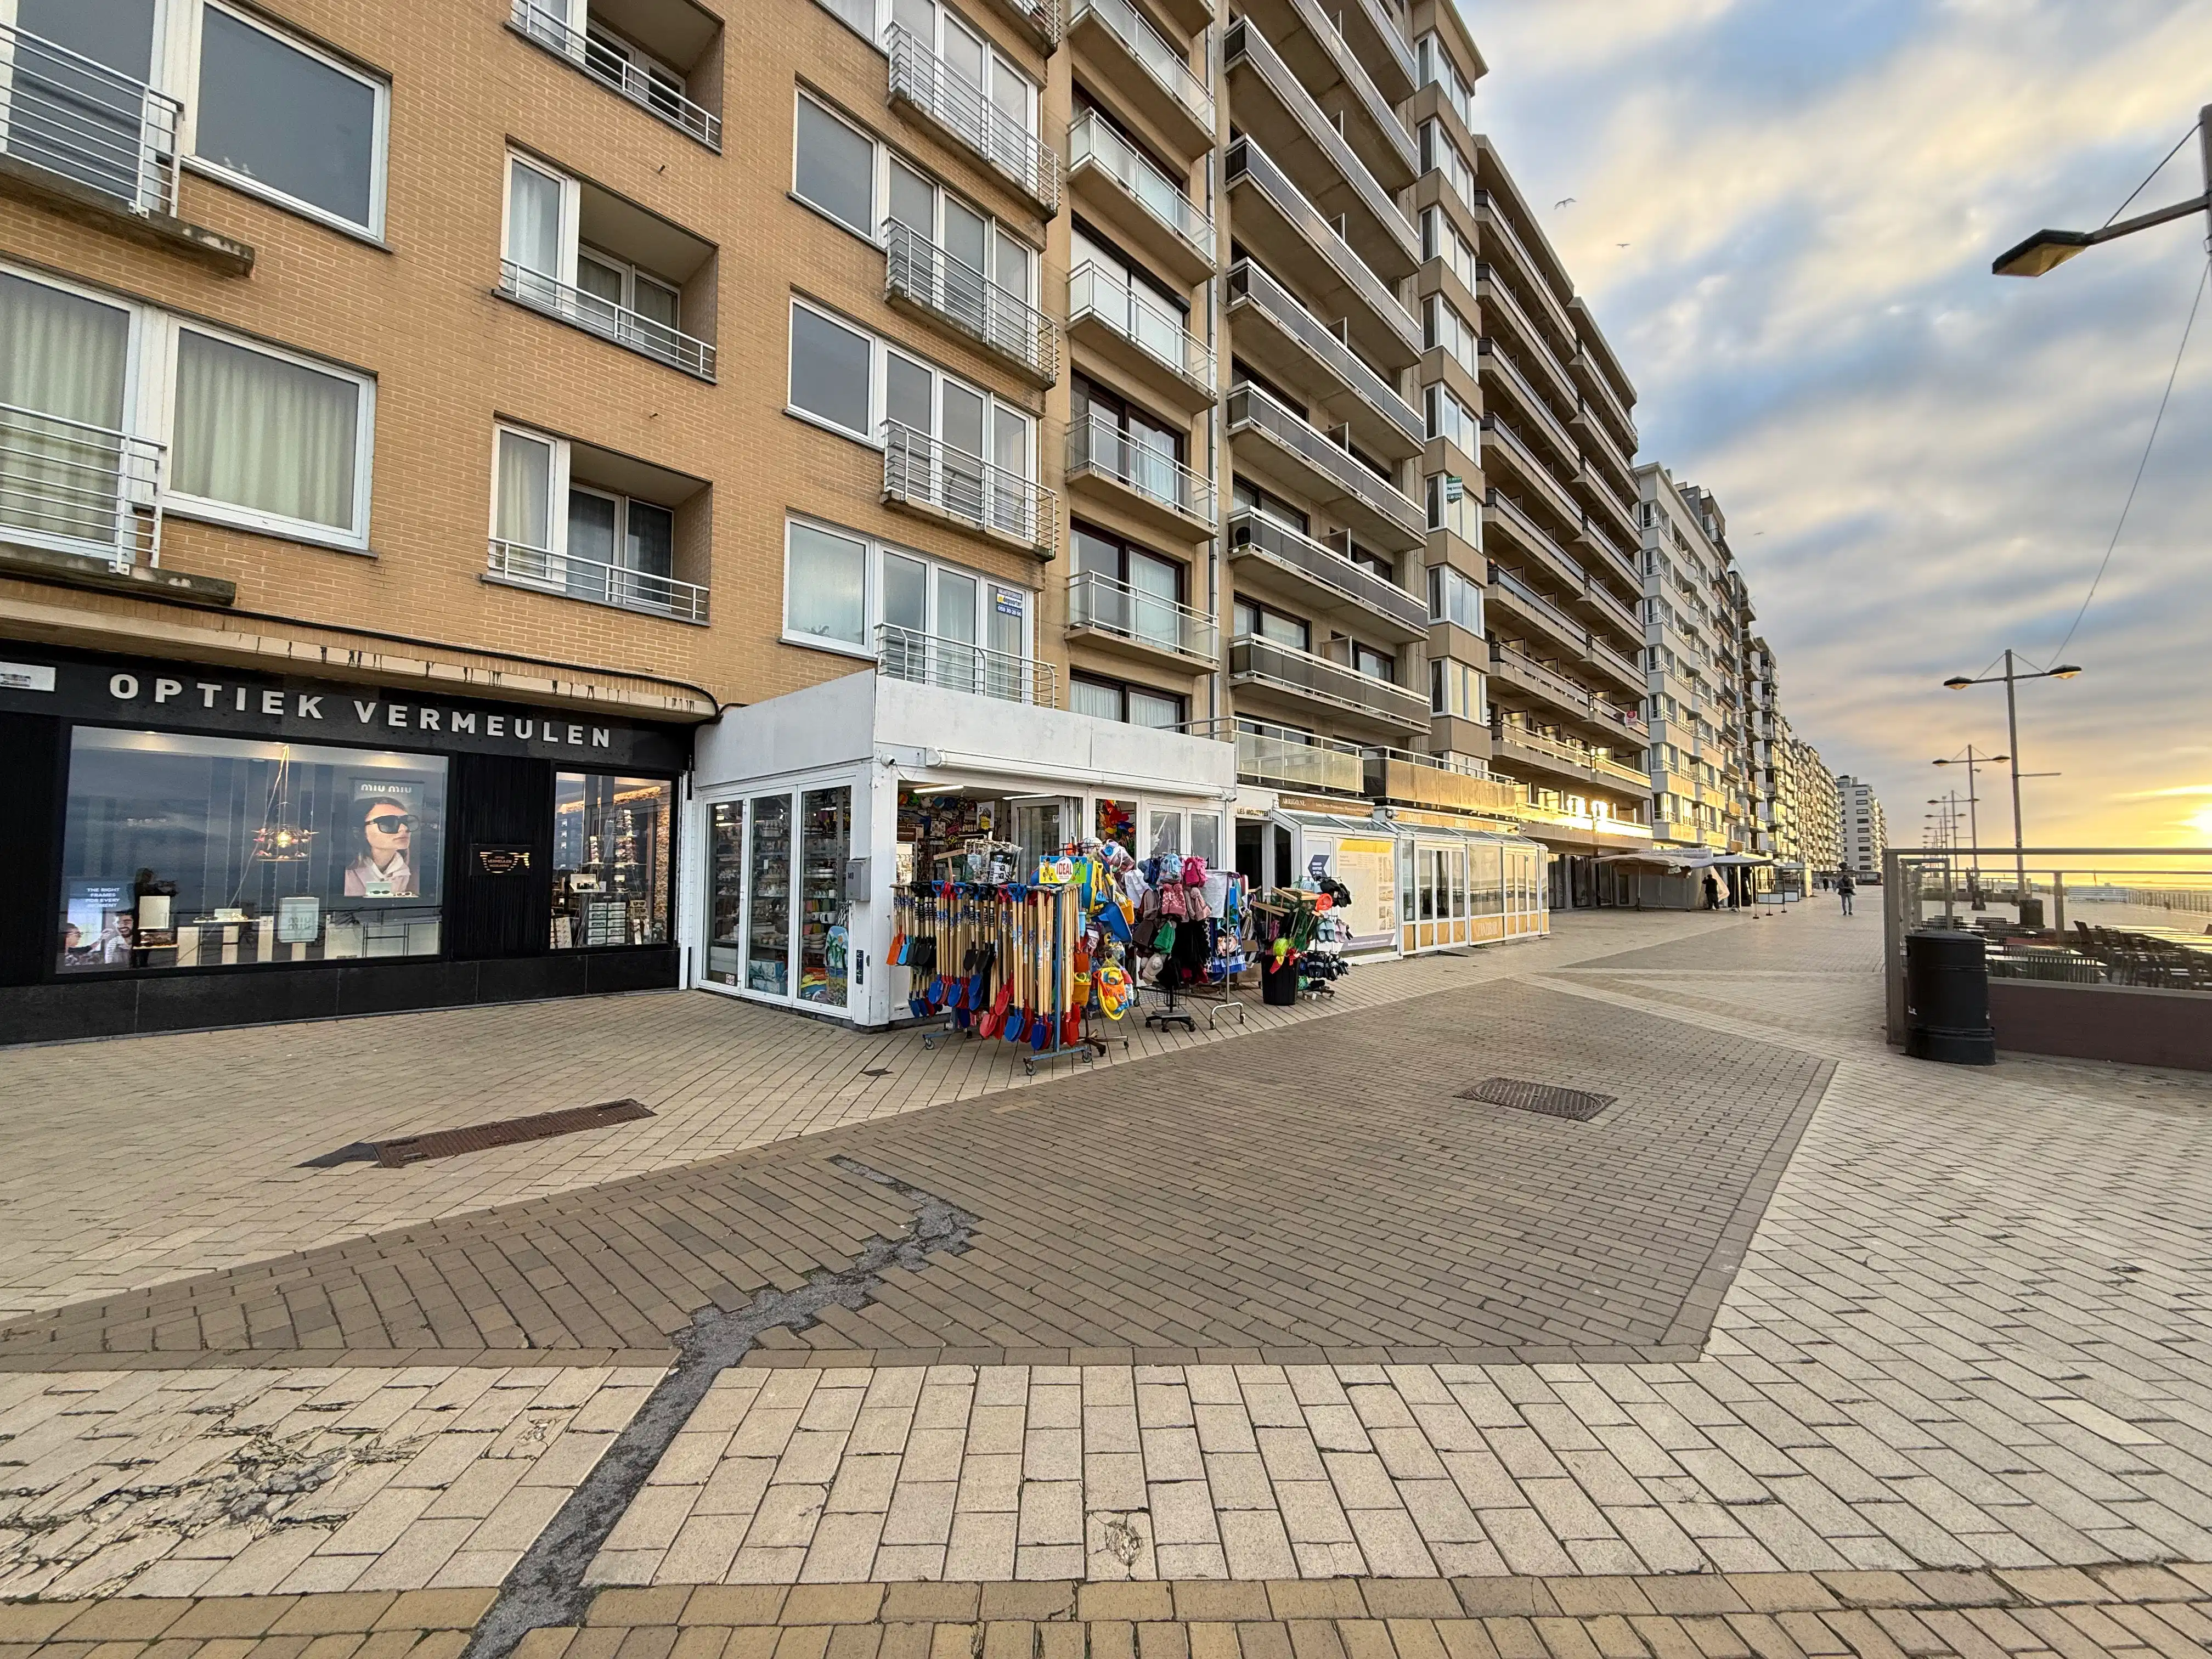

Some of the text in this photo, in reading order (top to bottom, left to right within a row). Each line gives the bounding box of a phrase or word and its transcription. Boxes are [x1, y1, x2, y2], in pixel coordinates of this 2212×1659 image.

[110, 674, 610, 748] OPTIEK VERMEULEN
[1057, 862, 1073, 875] IDEAL
